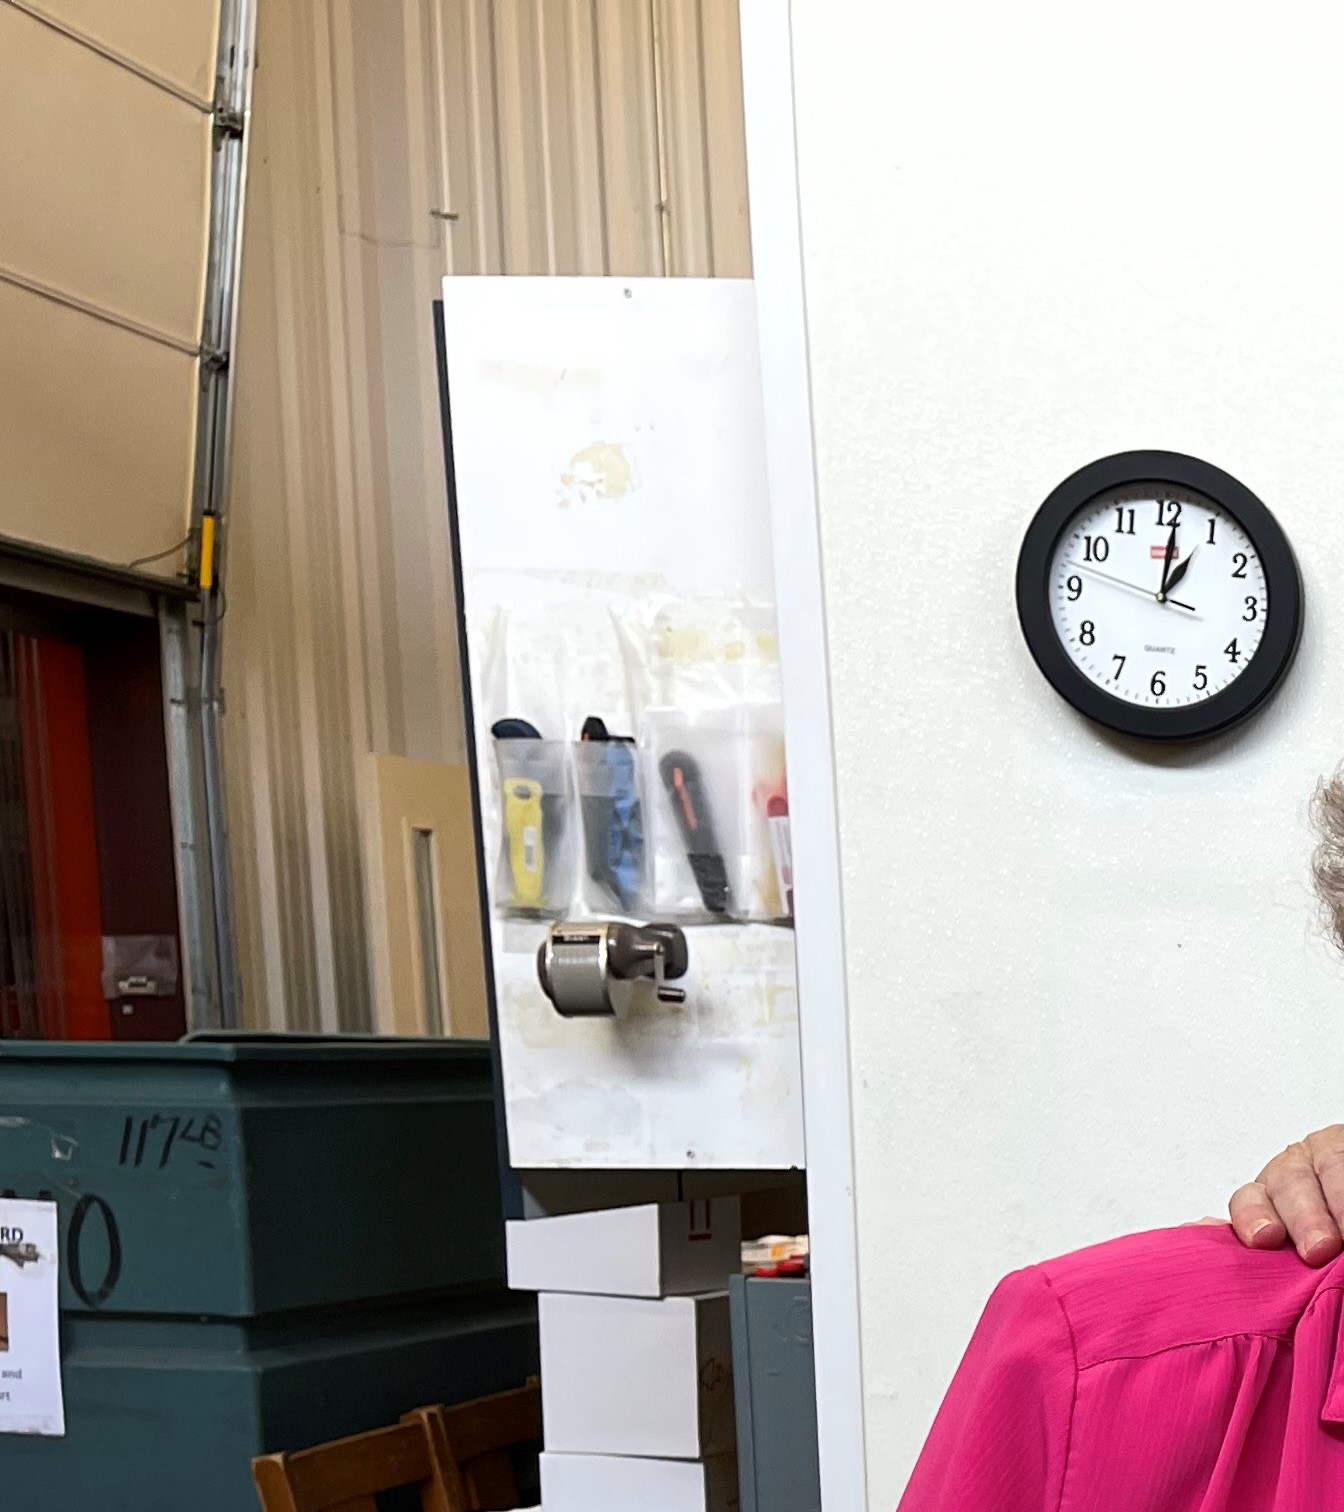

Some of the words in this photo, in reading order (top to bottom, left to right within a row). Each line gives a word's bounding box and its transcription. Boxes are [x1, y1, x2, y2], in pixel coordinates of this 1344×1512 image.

[1115, 507, 1136, 535] 11
[1155, 500, 1182, 528] 12
[1206, 518, 1216, 545] 1
[1083, 536, 1110, 562] 10
[1231, 553, 1248, 579] 2
[1066, 575, 1082, 601] 9
[1242, 596, 1257, 622] 3
[1079, 620, 1095, 646] 8
[1223, 638, 1241, 663] 4
[1112, 655, 1126, 681] 7
[1193, 665, 1207, 690] 5
[1150, 671, 1166, 696] 6
